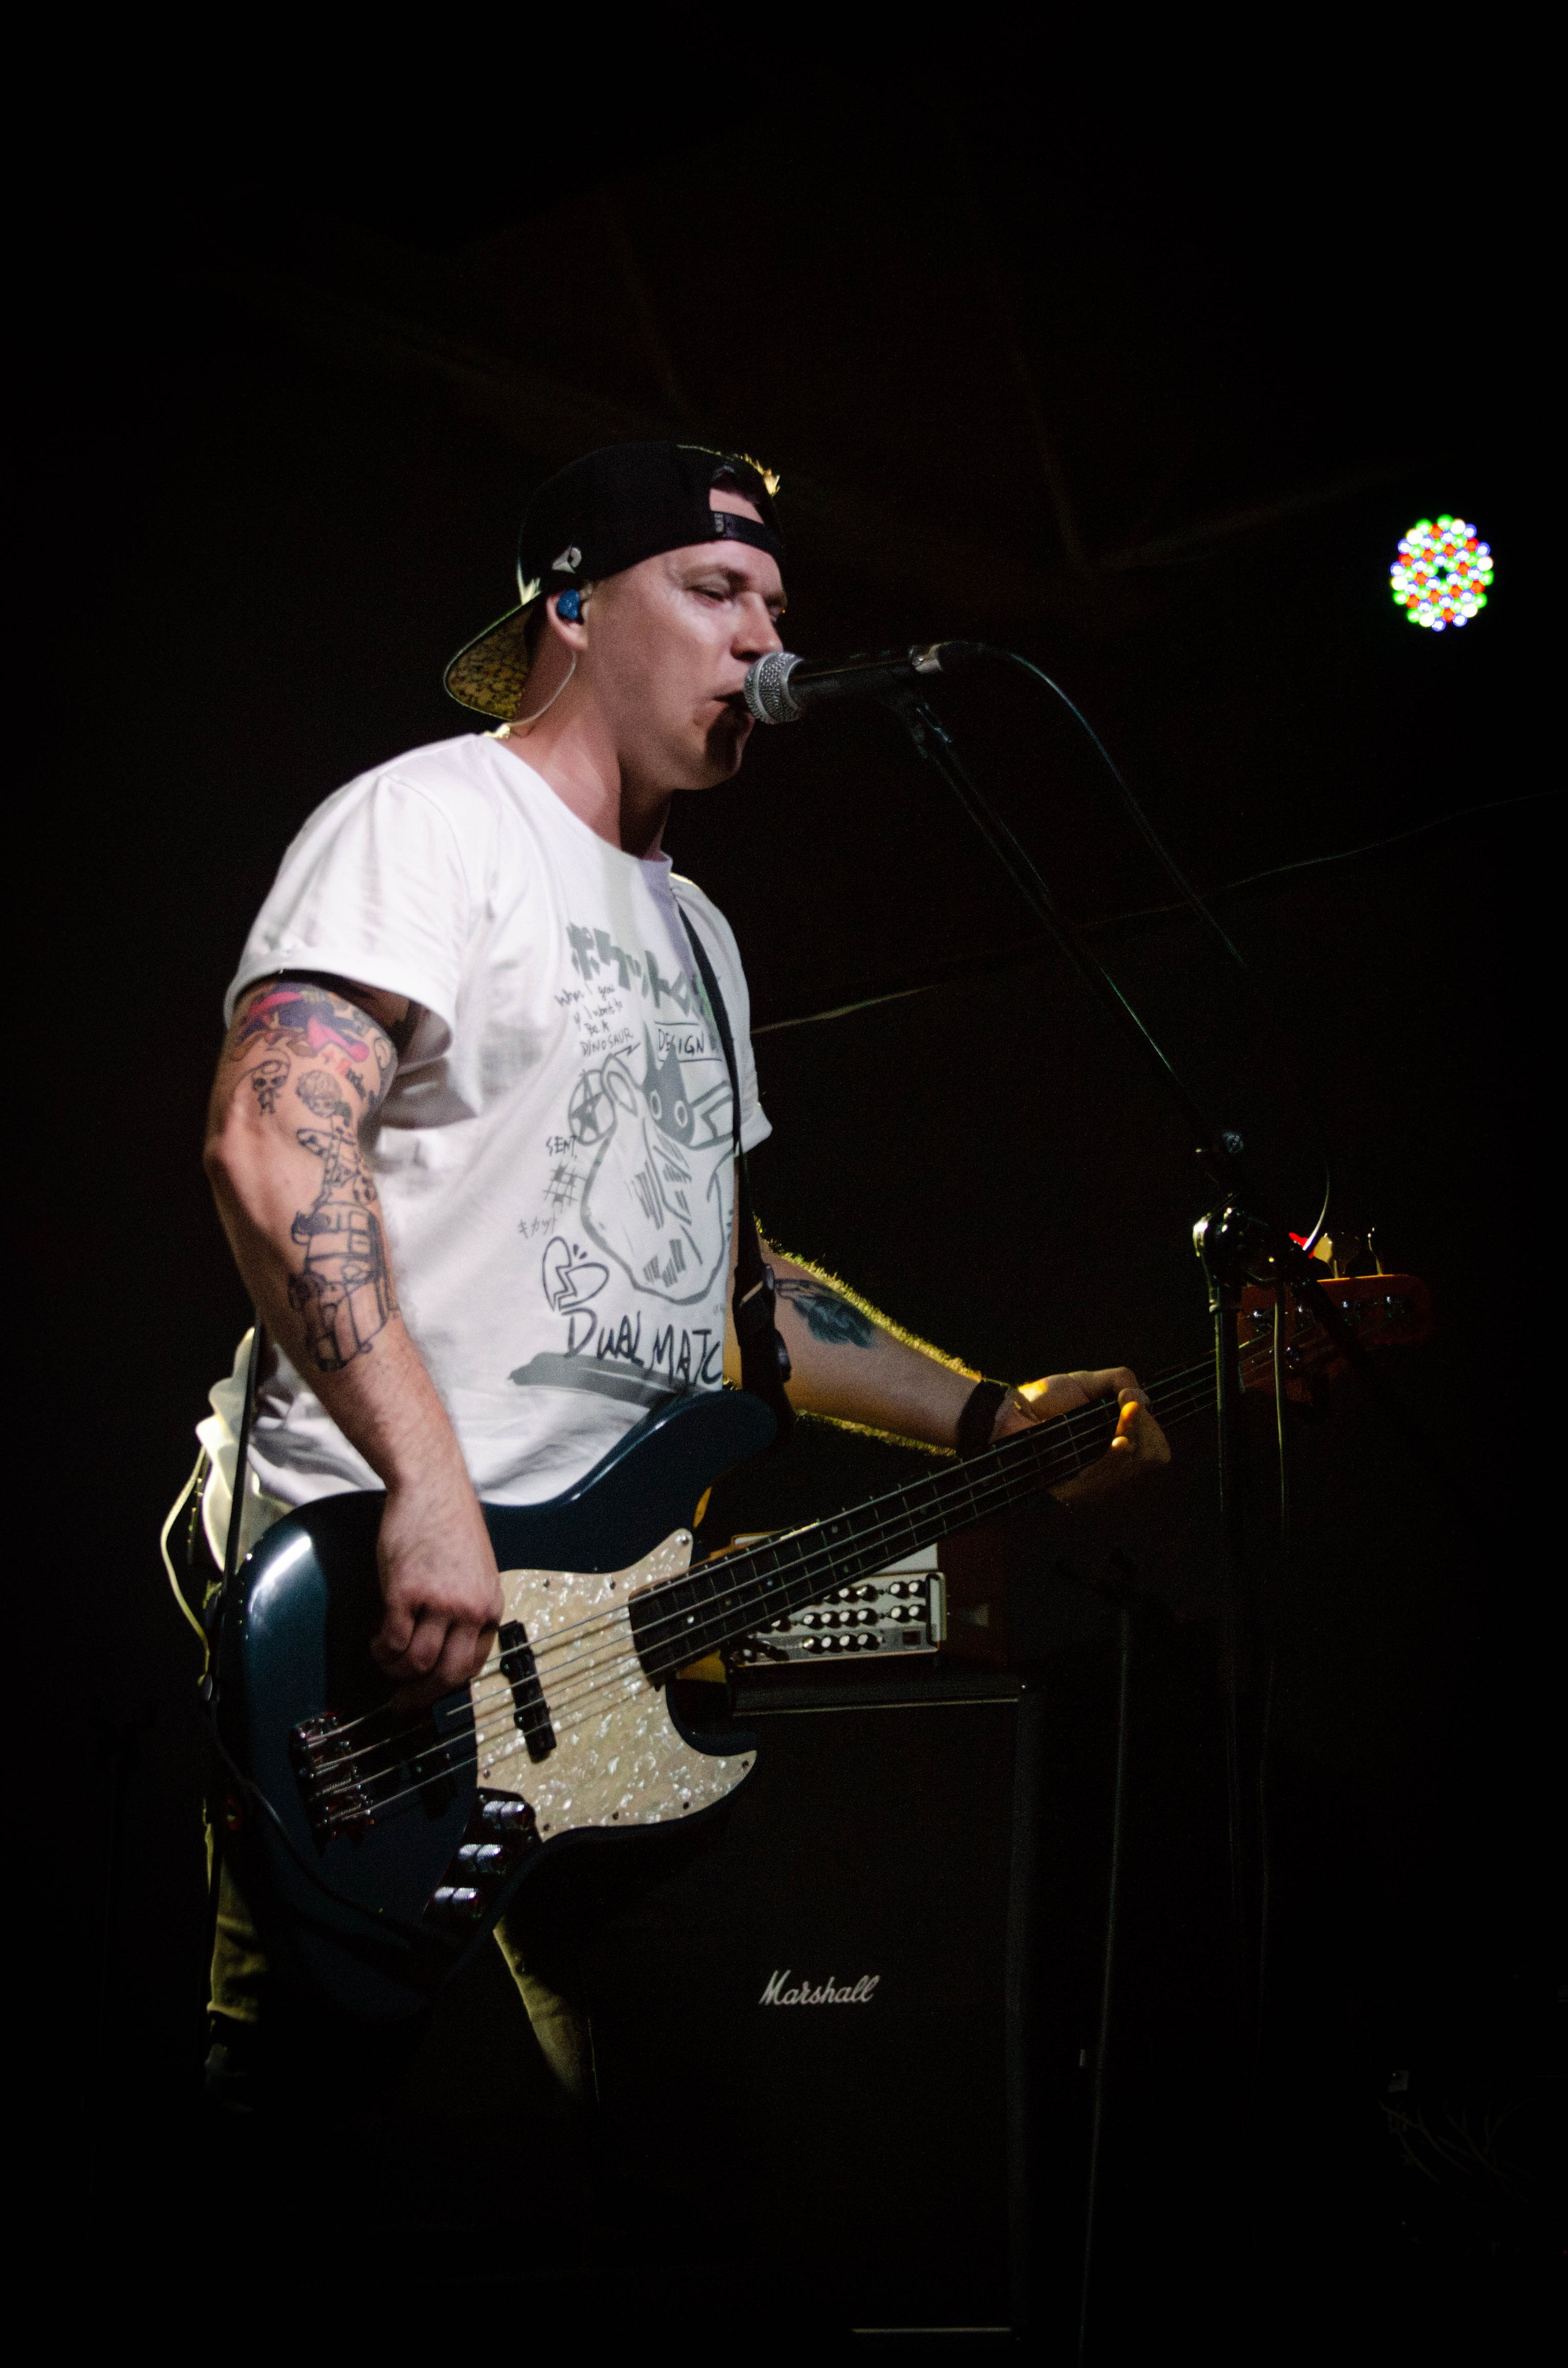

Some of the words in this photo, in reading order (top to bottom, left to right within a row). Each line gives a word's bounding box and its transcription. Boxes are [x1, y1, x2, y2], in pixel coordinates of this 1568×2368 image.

[579, 1027, 634, 1057] DINOSAUR
[658, 1029, 705, 1056] DESIGN
[759, 1969, 880, 2005] Marshall
